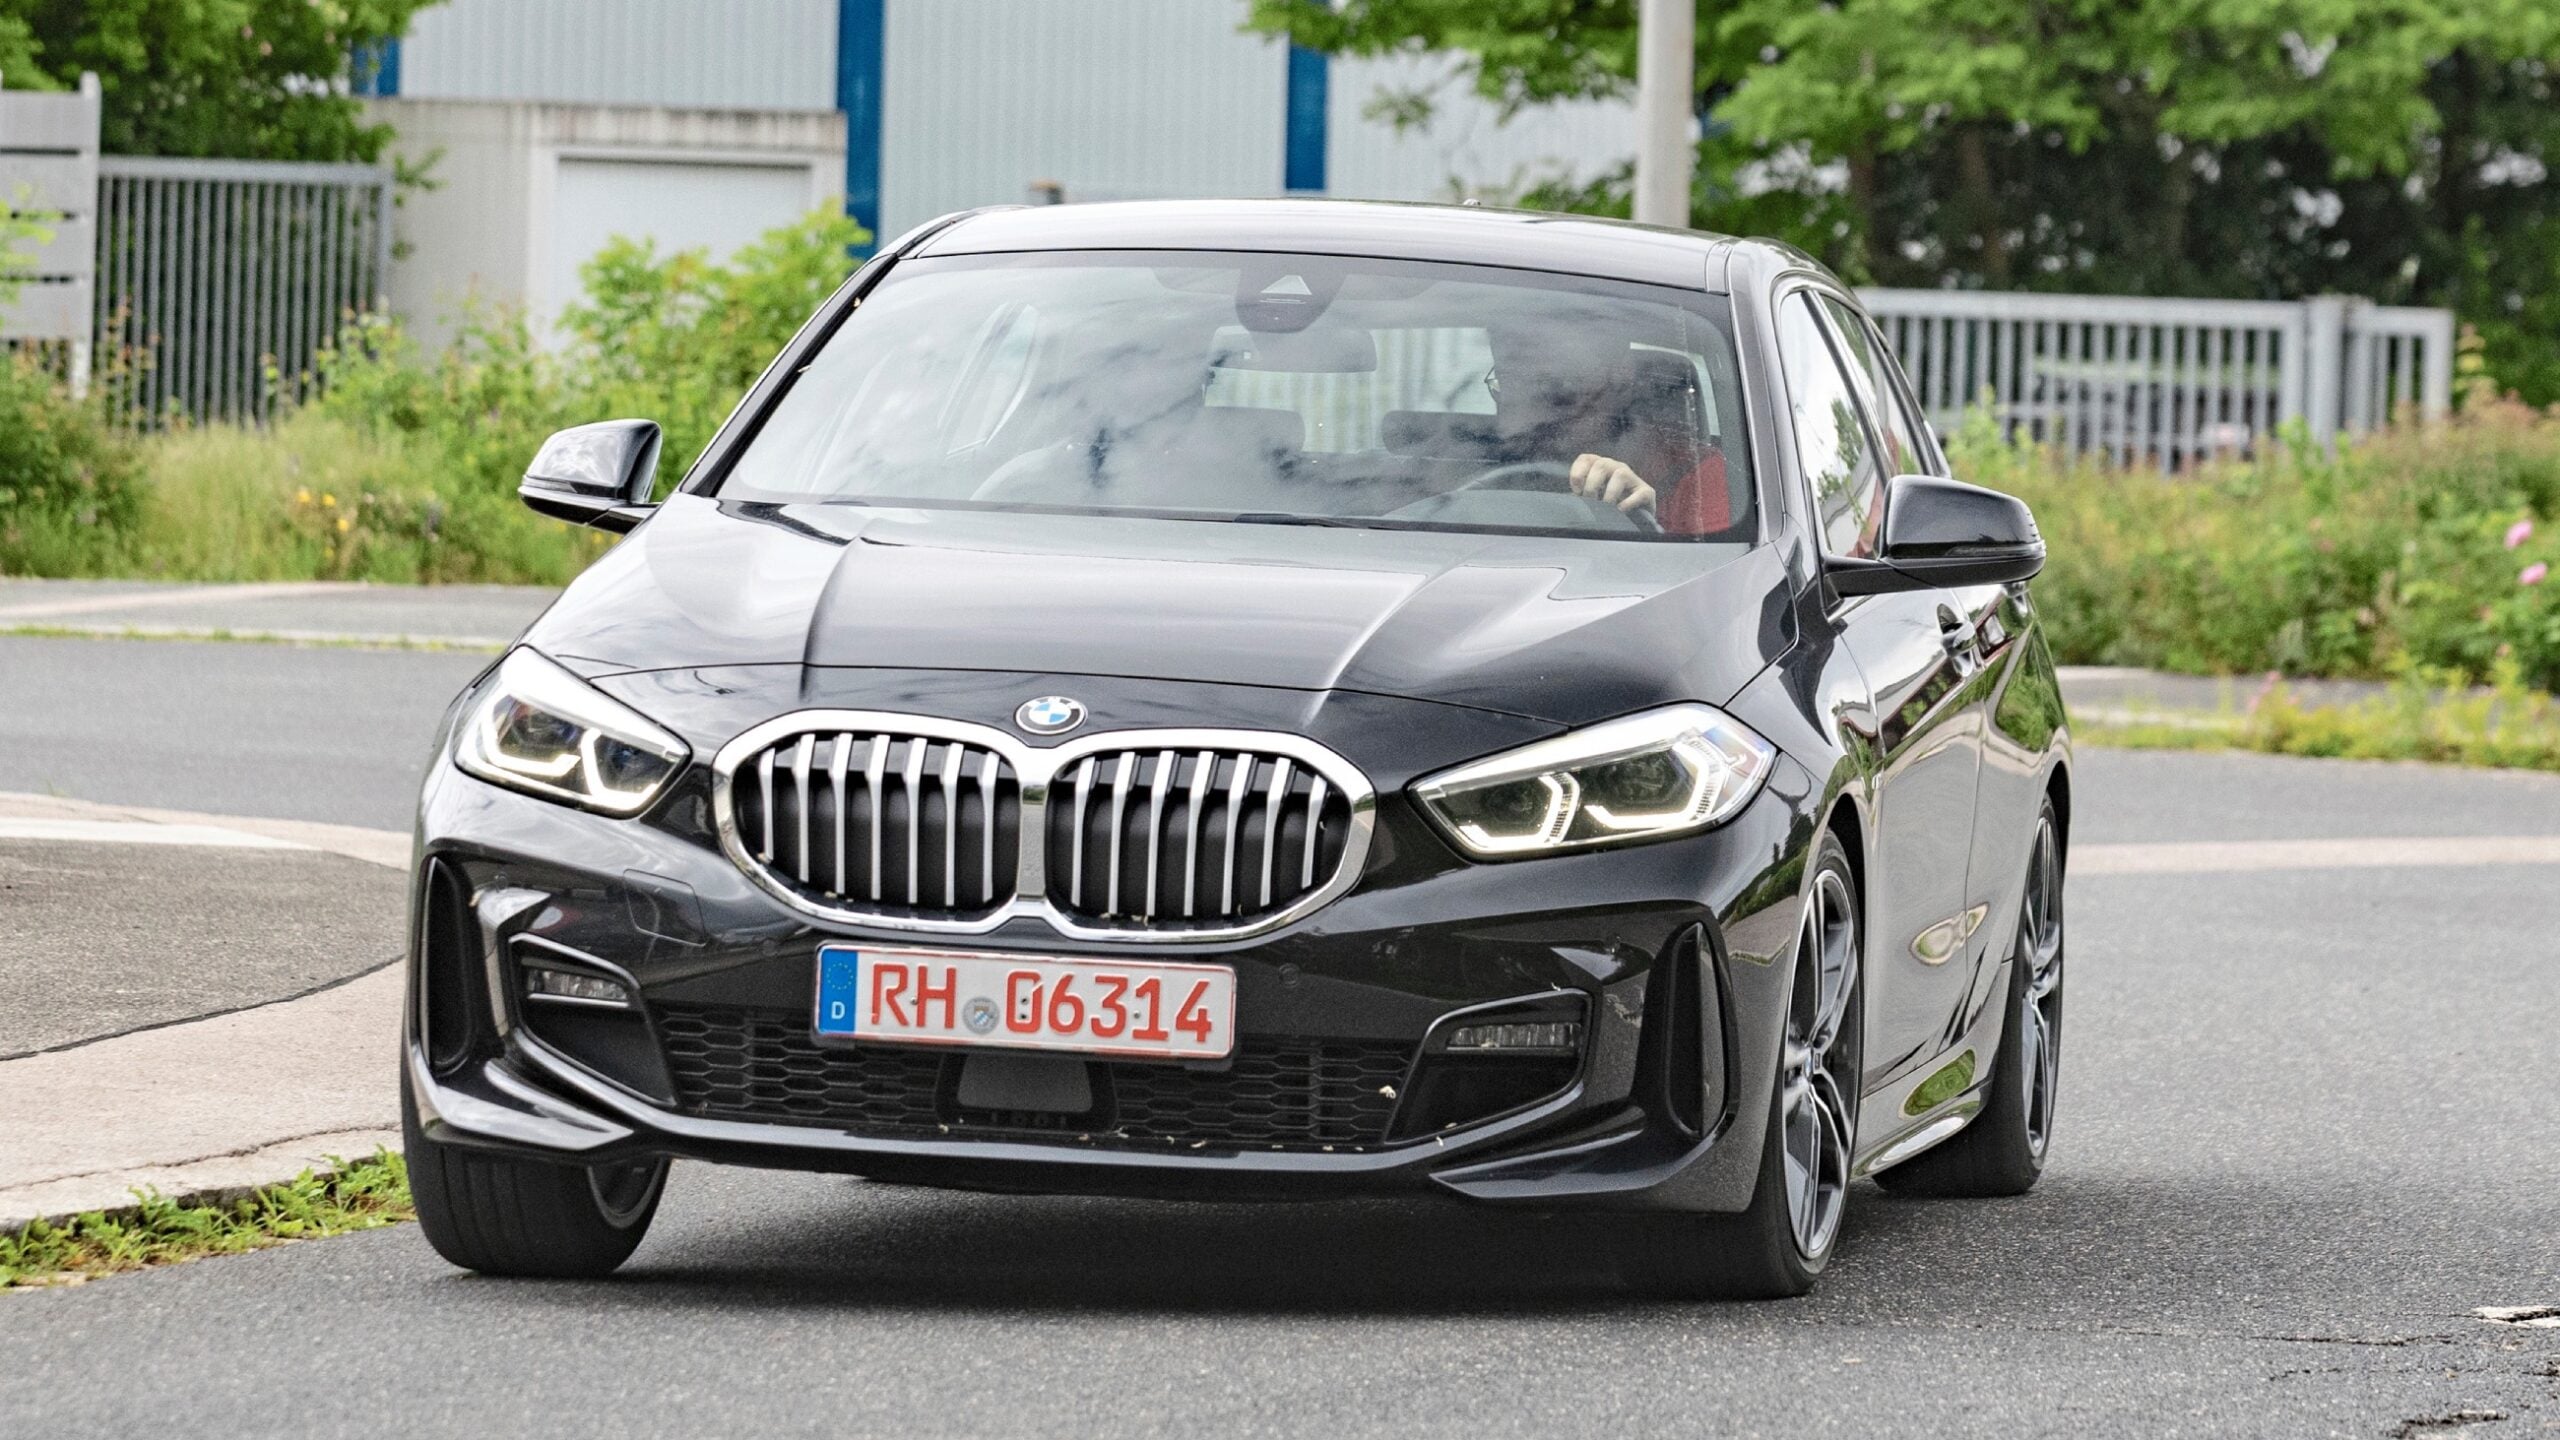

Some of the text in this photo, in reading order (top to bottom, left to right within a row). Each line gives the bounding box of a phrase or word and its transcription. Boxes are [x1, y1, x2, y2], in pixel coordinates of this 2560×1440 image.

[831, 1001, 845, 1019] D
[871, 963, 957, 1029] RH
[1005, 972, 1213, 1043] 06314
